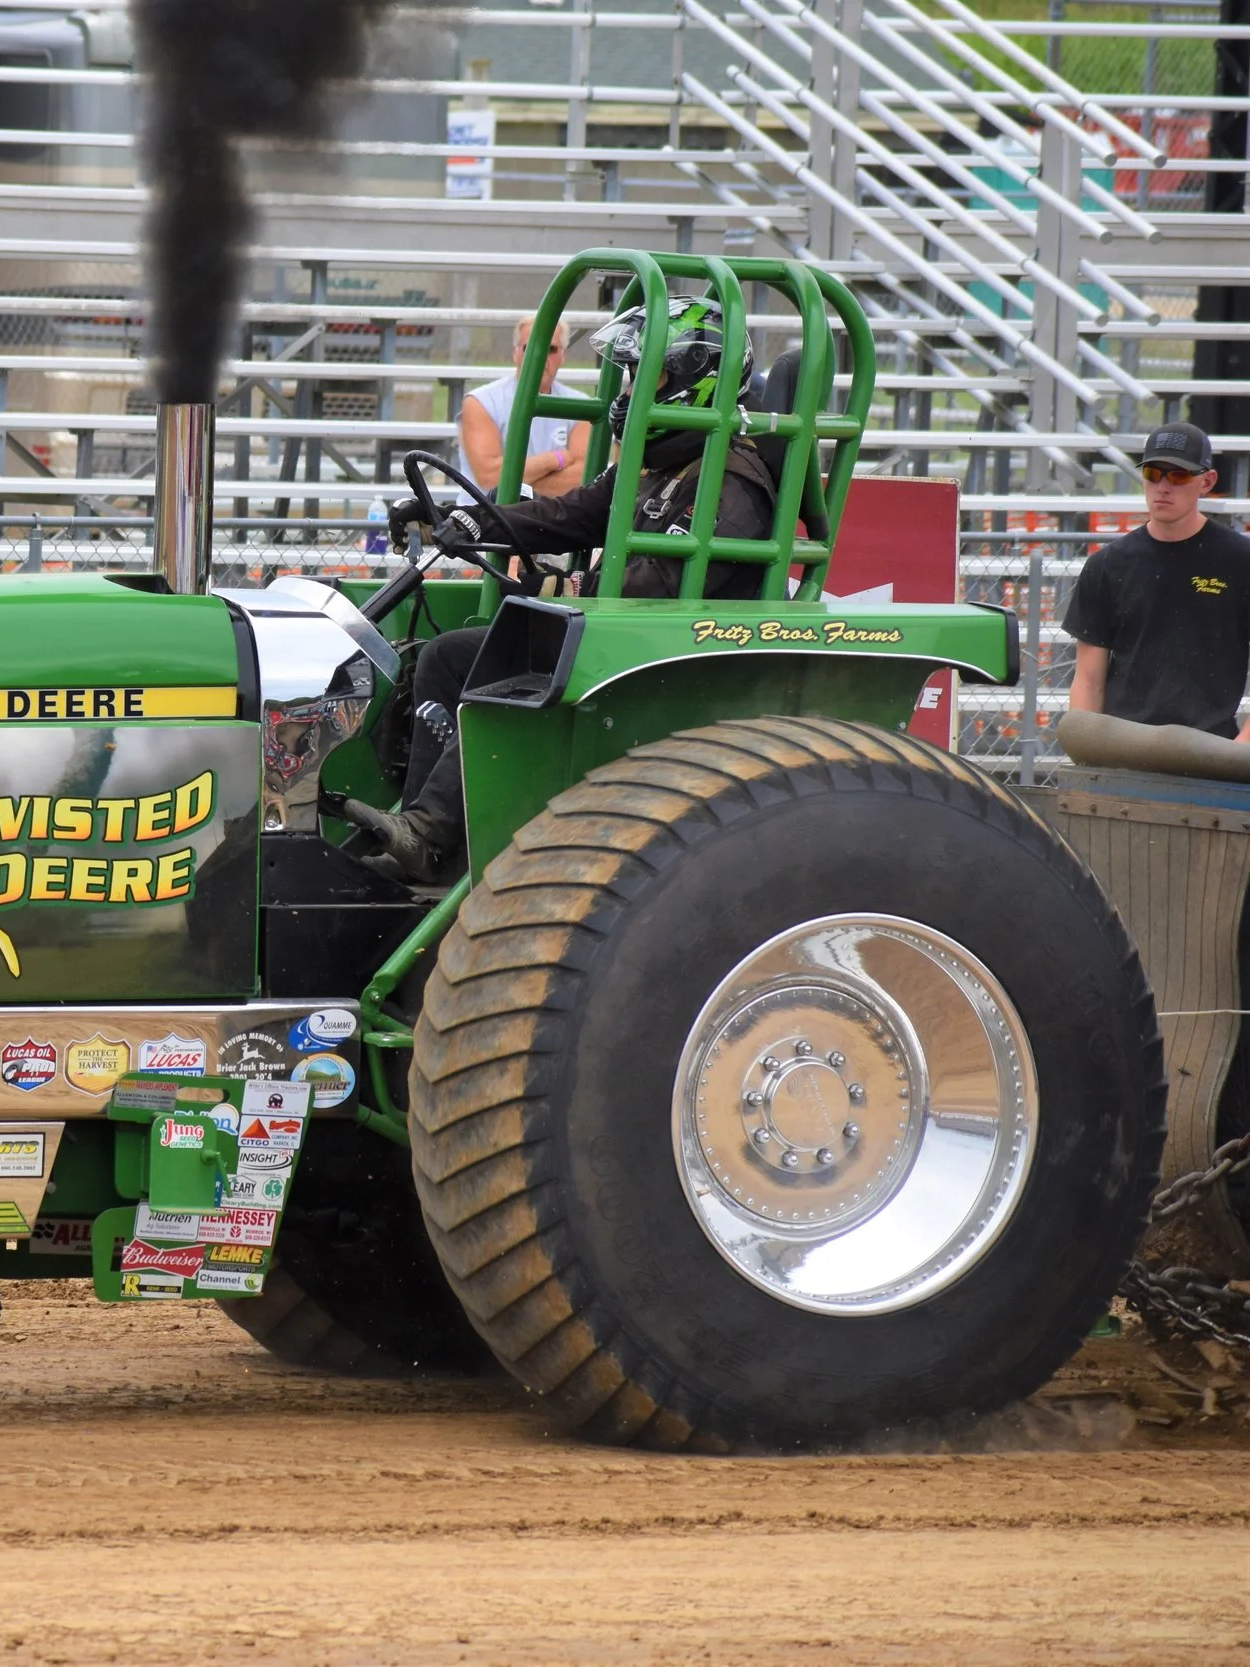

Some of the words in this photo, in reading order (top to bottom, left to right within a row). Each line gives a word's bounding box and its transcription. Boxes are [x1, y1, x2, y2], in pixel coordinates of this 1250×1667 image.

[692, 620, 753, 646] Fritz
[759, 621, 819, 642] Bros.
[822, 621, 903, 644] Farms
[6, 688, 145, 718] DEERE
[323, 1021, 352, 1030] QUAMME
[225, 1033, 248, 1047] LOVING
[248, 1032, 277, 1046] MEMORY
[6, 1048, 37, 1058] LUCAS
[37, 1047, 51, 1057] OIL
[78, 1049, 119, 1057] PROTECT
[78, 1061, 119, 1069] HARVEST
[147, 1053, 202, 1067] LUCAS
[216, 1063, 236, 1072] Briar
[239, 1062, 257, 1072] Jack
[259, 1062, 286, 1071] Brown
[161, 1119, 204, 1146] Jung
[239, 1153, 278, 1163] INSIGHT
[149, 1212, 192, 1223] Nutrien
[122, 1247, 203, 1266] Budweiser
[209, 1245, 264, 1264] LEMKE
[199, 1274, 241, 1284] Channel
[123, 1275, 141, 1297] R
